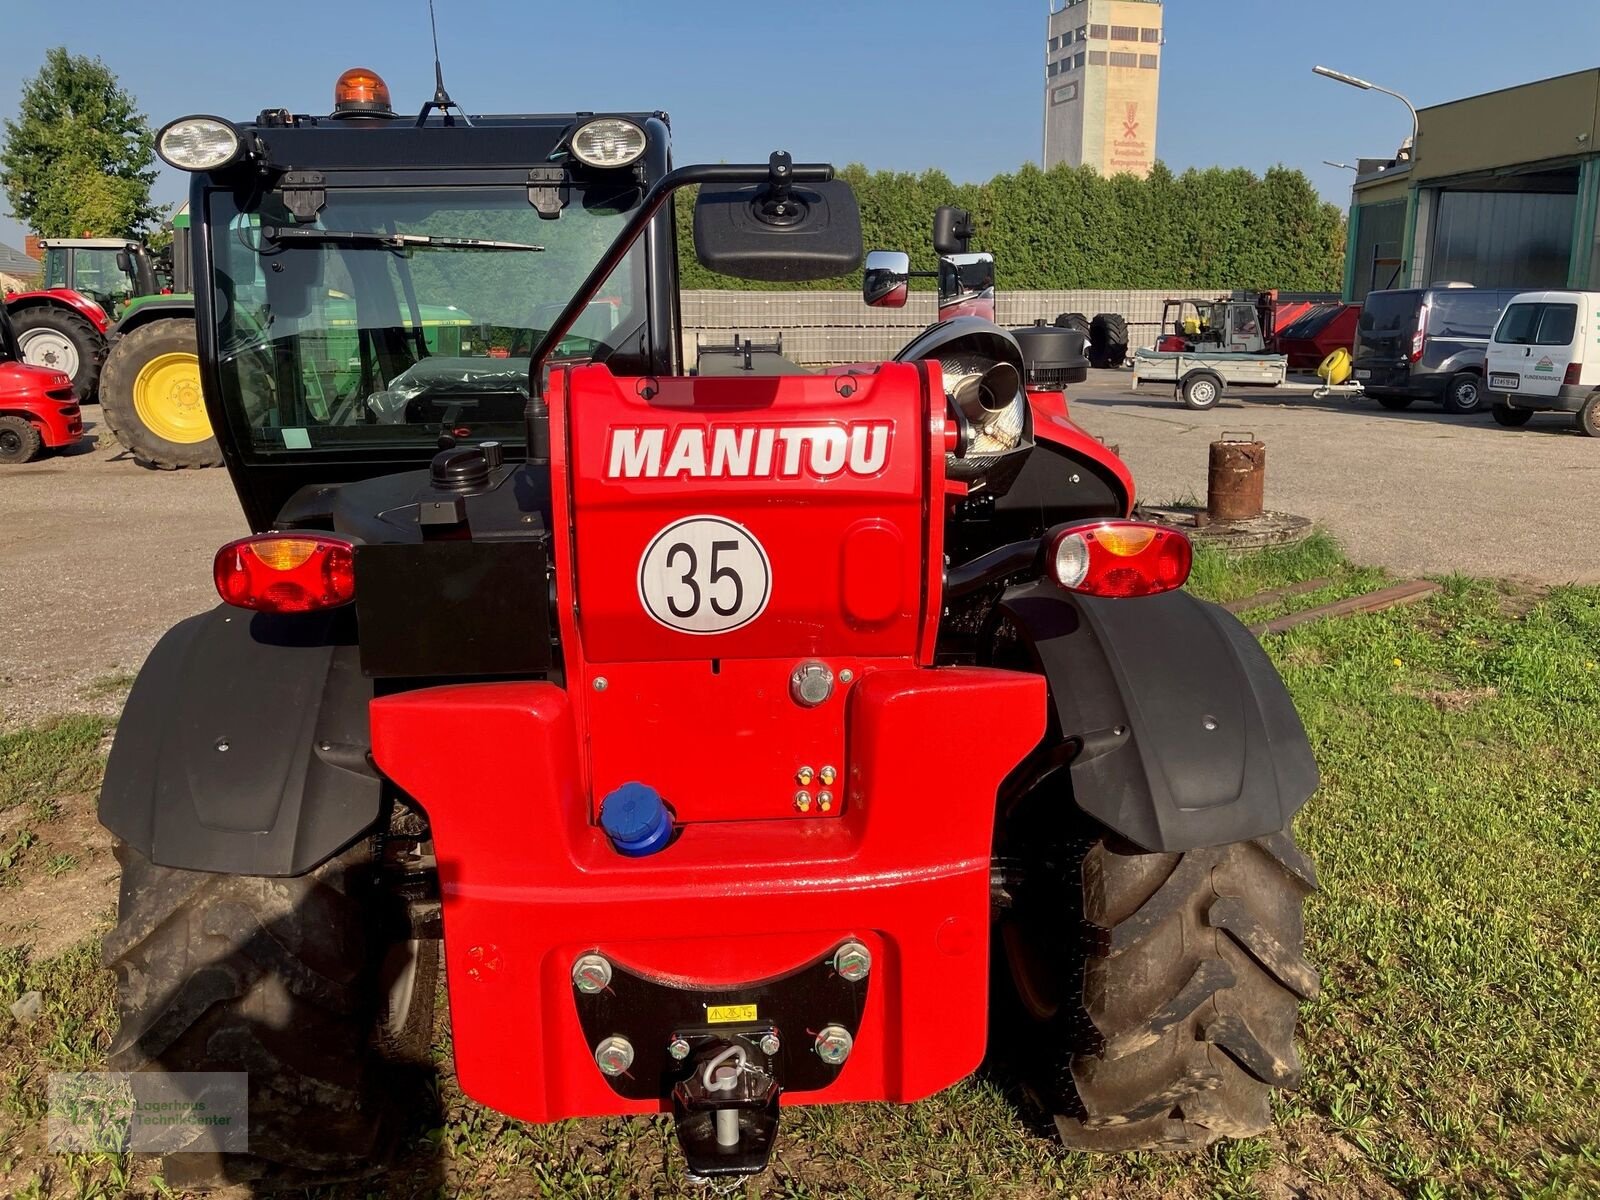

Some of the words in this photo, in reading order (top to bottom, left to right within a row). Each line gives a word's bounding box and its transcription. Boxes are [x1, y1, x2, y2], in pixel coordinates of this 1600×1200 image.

[1524, 374, 1561, 382] KUNDENSERVICE
[608, 426, 889, 478] MANITOU
[666, 540, 743, 618] 35
